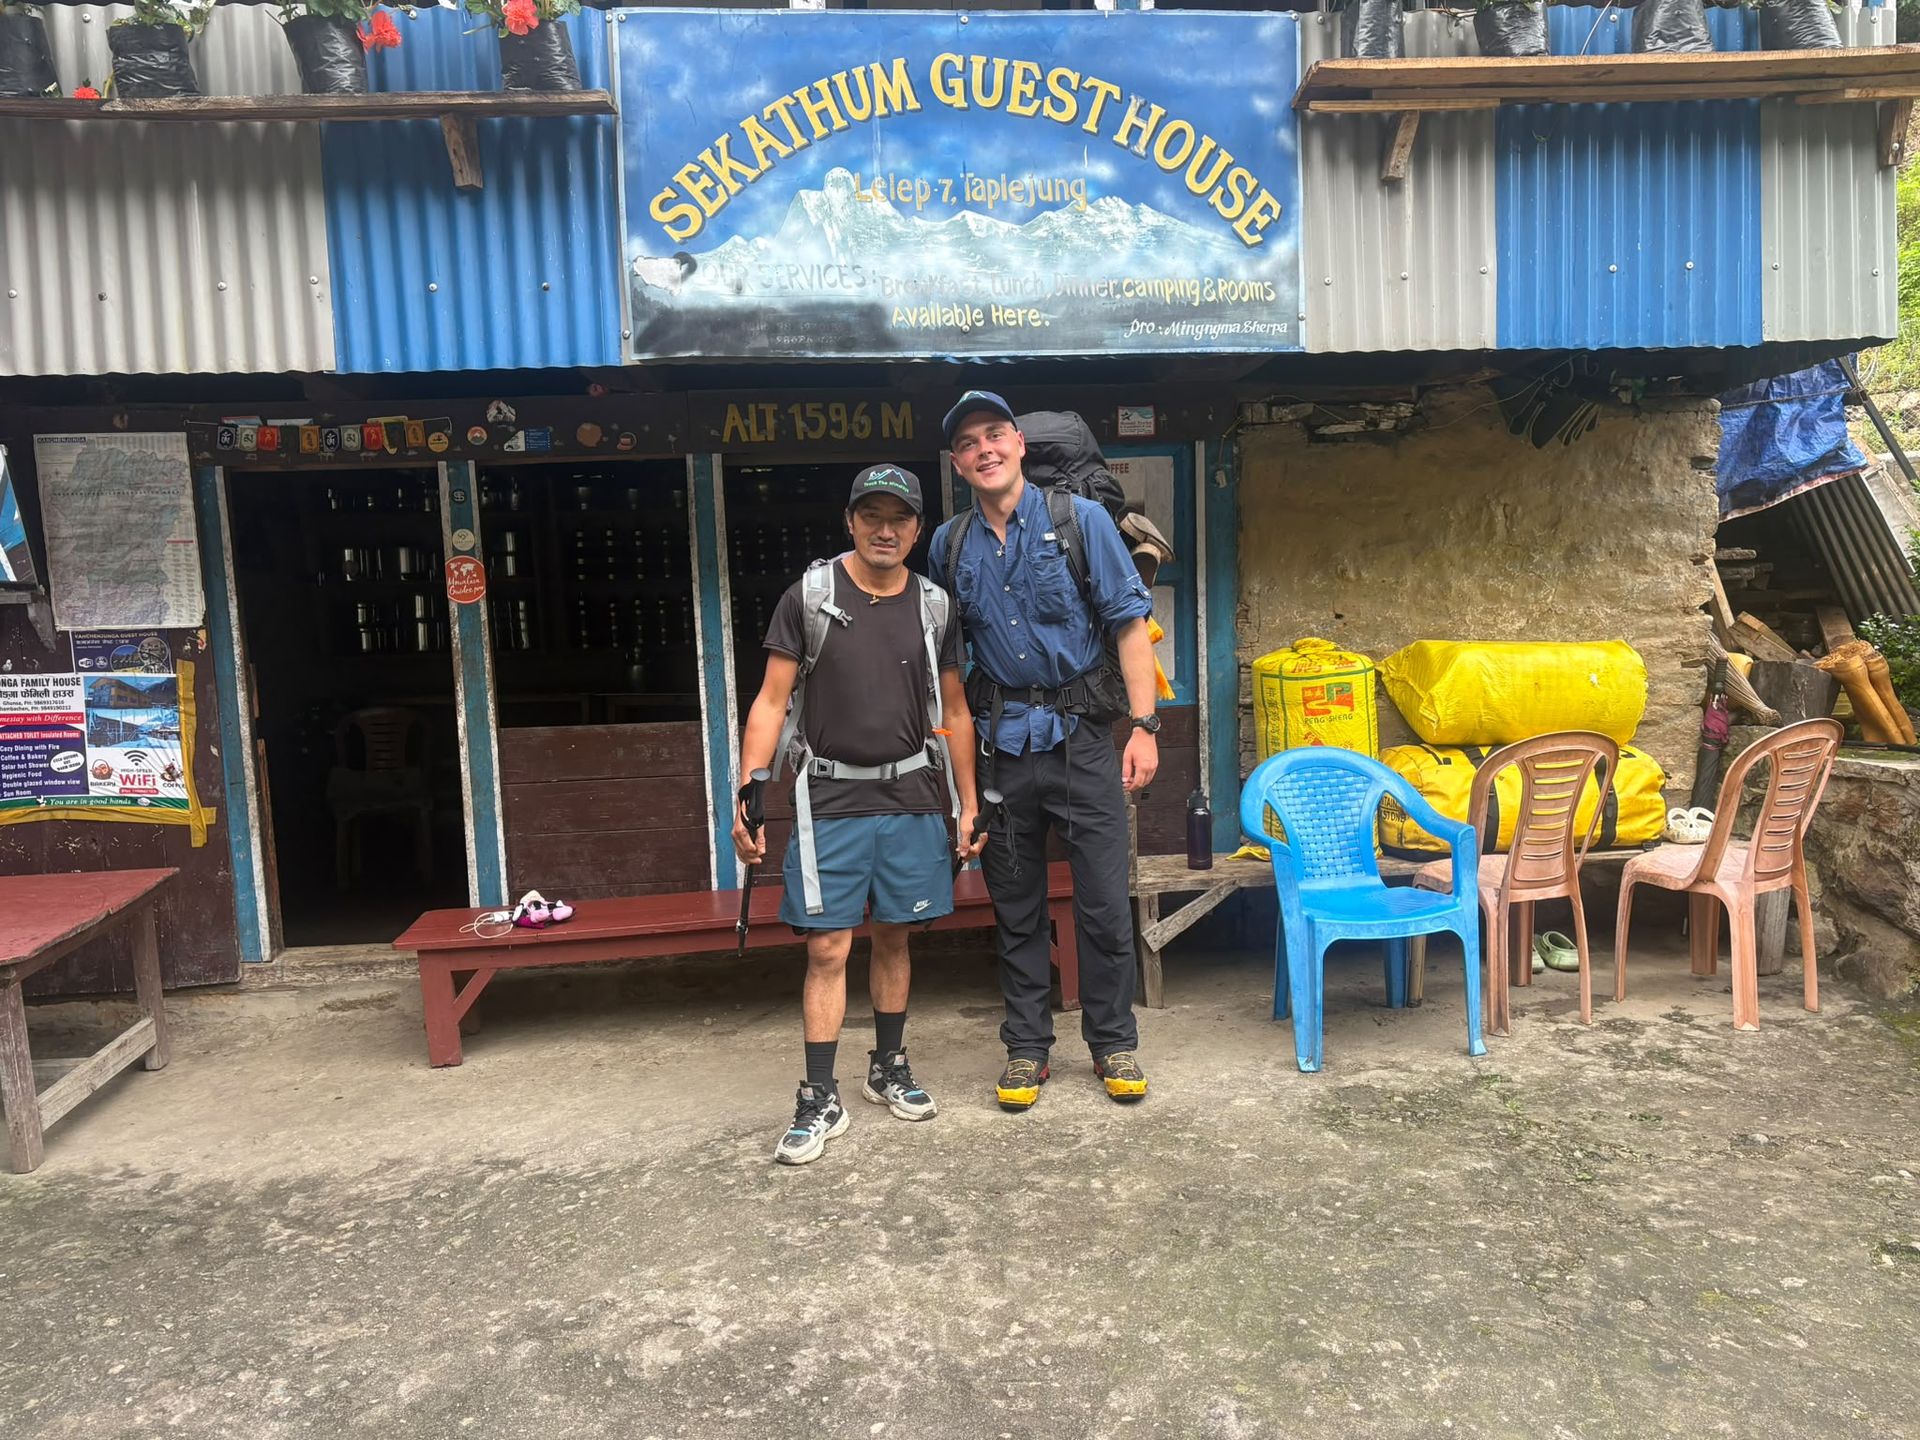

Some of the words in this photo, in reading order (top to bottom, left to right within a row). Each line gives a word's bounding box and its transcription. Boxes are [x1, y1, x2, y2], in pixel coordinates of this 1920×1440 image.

[649, 57, 922, 244] SEKATHUM
[929, 52, 1122, 135] GUEST
[1113, 91, 1282, 247] HOUSE
[963, 172, 1088, 212] Taplejung
[891, 302, 985, 329] Available
[990, 303, 1050, 329] Here.
[1240, 319, 1289, 336] Sherpa
[788, 401, 873, 441] 1596
[881, 401, 914, 440] M
[0, 678, 19, 688] NGA
[21, 677, 51, 688] FAMILY
[53, 676, 81, 687] HOUSE
[0, 716, 25, 724] mestay
[26, 715, 42, 723] with
[44, 714, 82, 723] Difference
[119, 773, 157, 787] WiFi
[49, 798, 64, 806] You
[88, 798, 108, 806] good
[109, 797, 132, 805] hands
